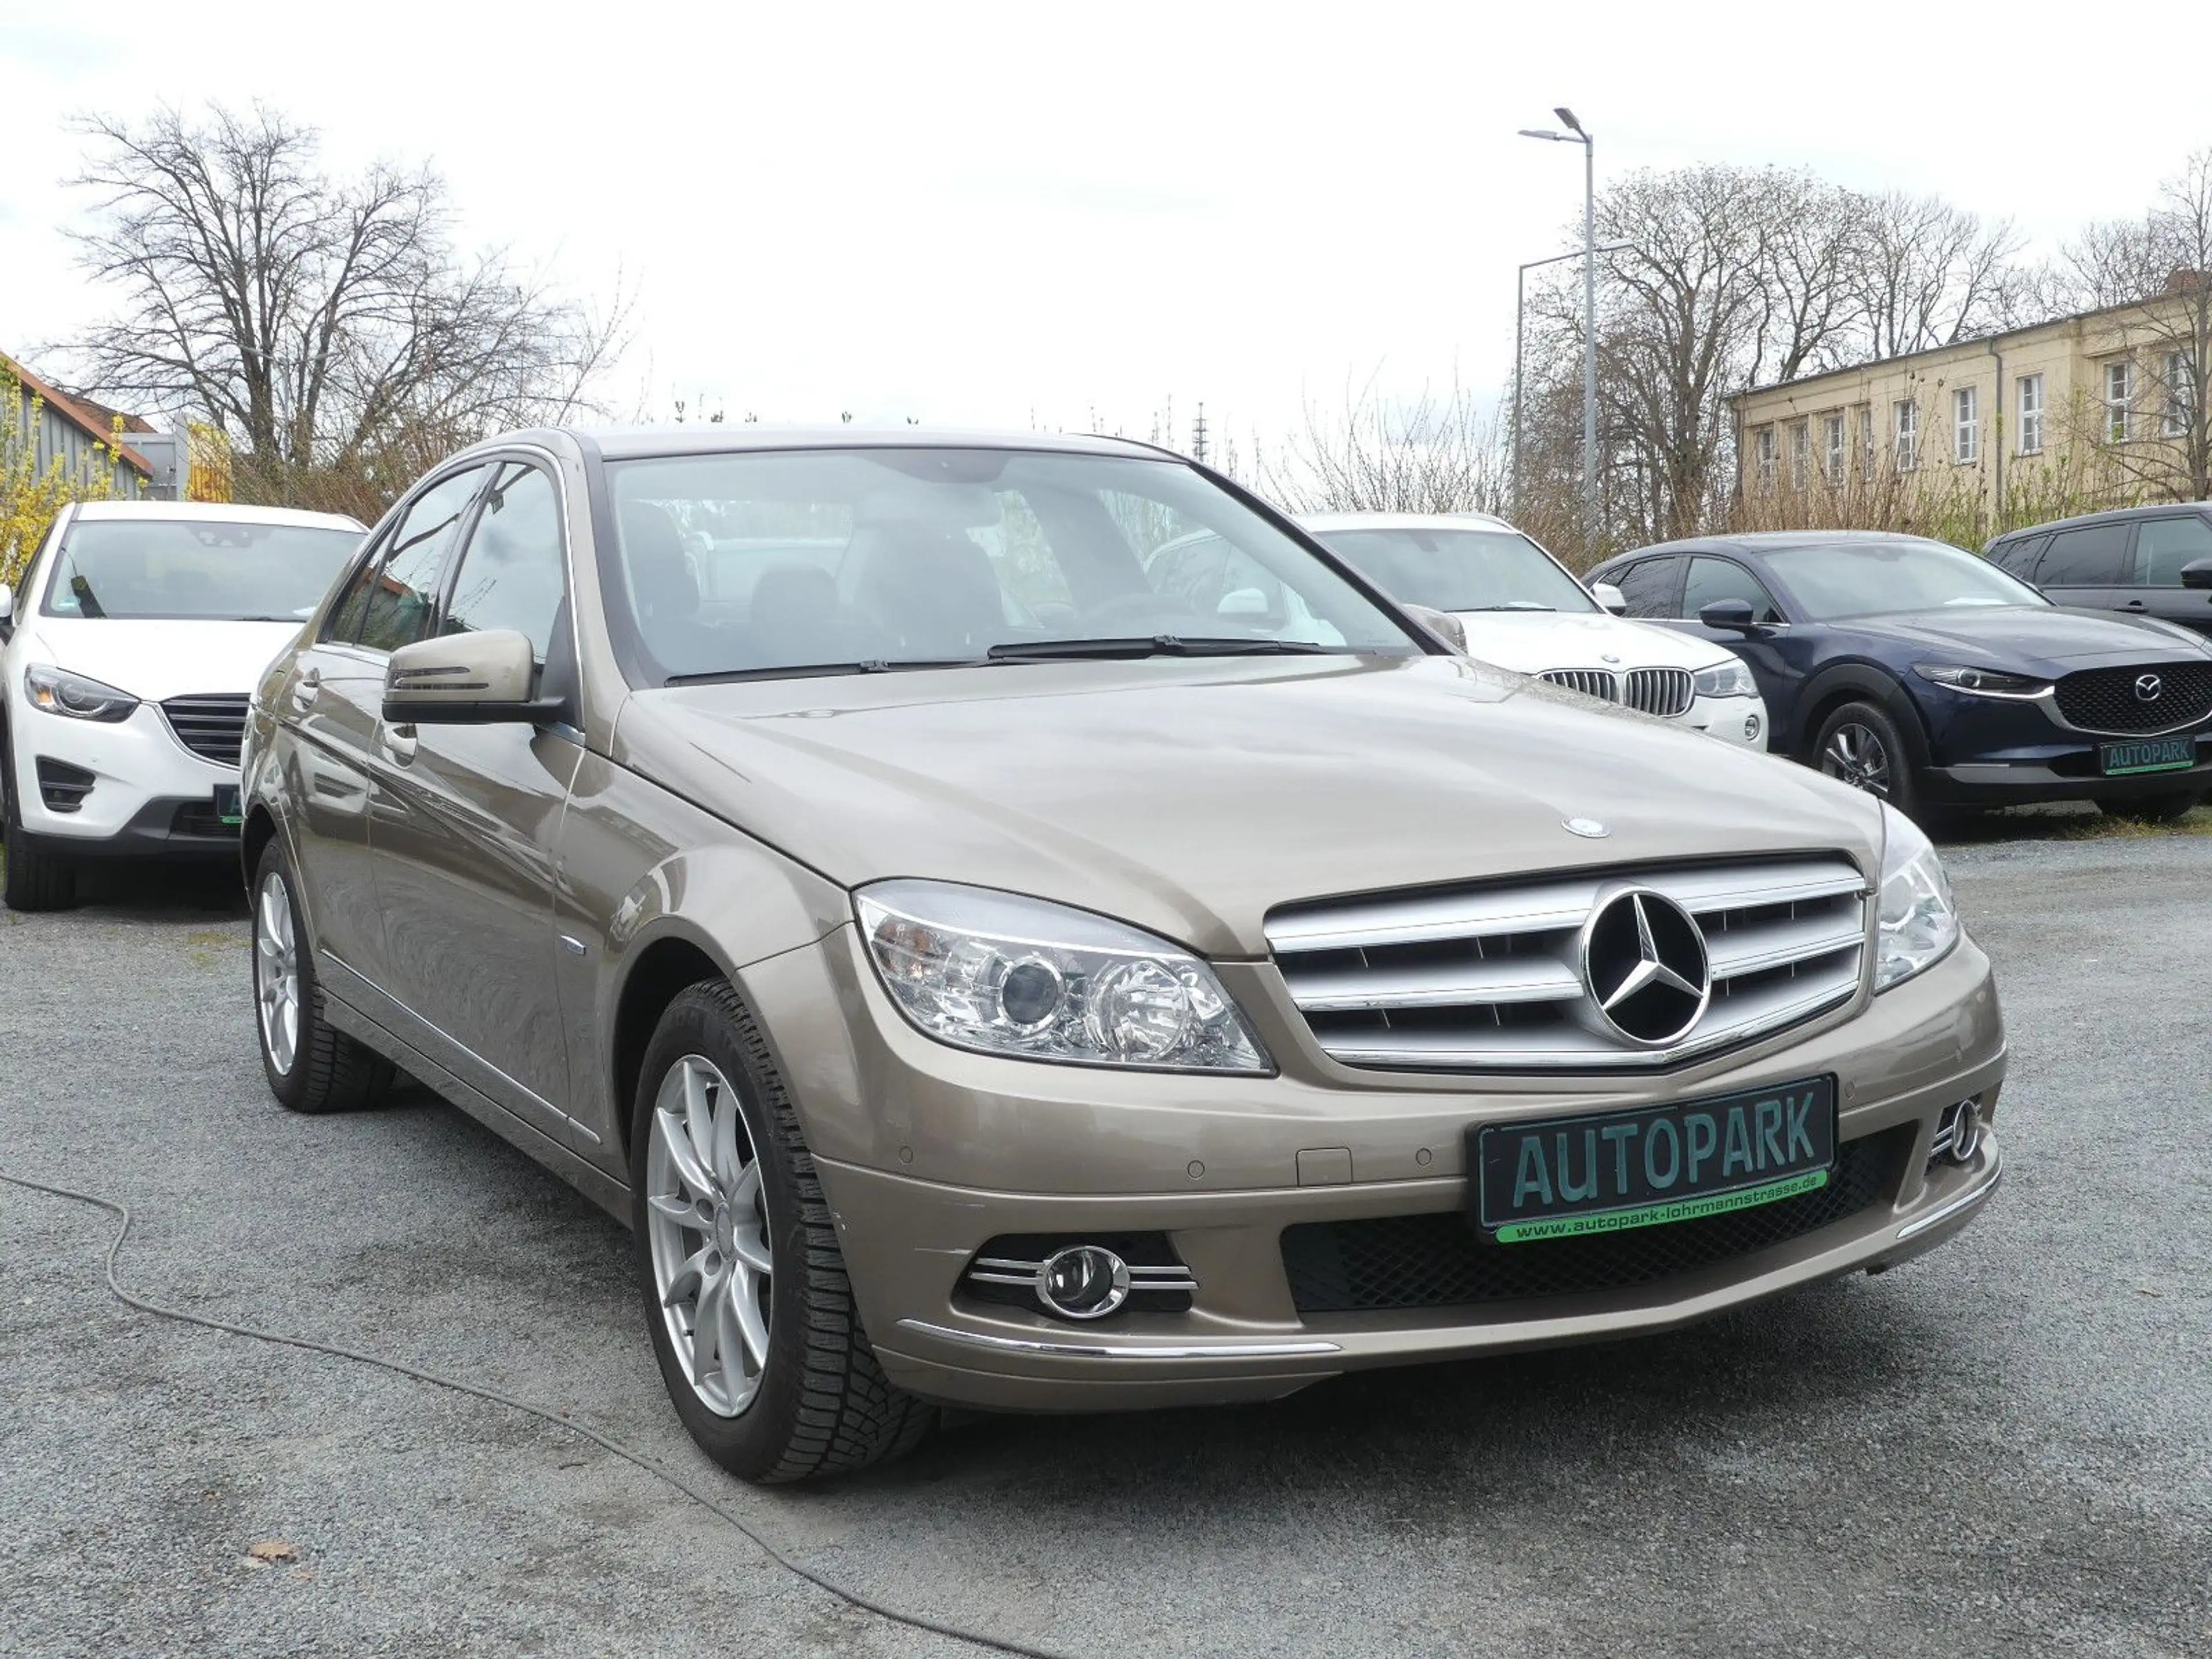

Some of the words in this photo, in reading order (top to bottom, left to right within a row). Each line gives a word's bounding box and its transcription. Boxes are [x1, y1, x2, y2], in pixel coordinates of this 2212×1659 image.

[2109, 741, 2190, 767] AUTOPARK
[1512, 1092, 1813, 1207] AUTOPARK
[1516, 1176, 1817, 1238] www.autopark-lohrmannstrasse.de
